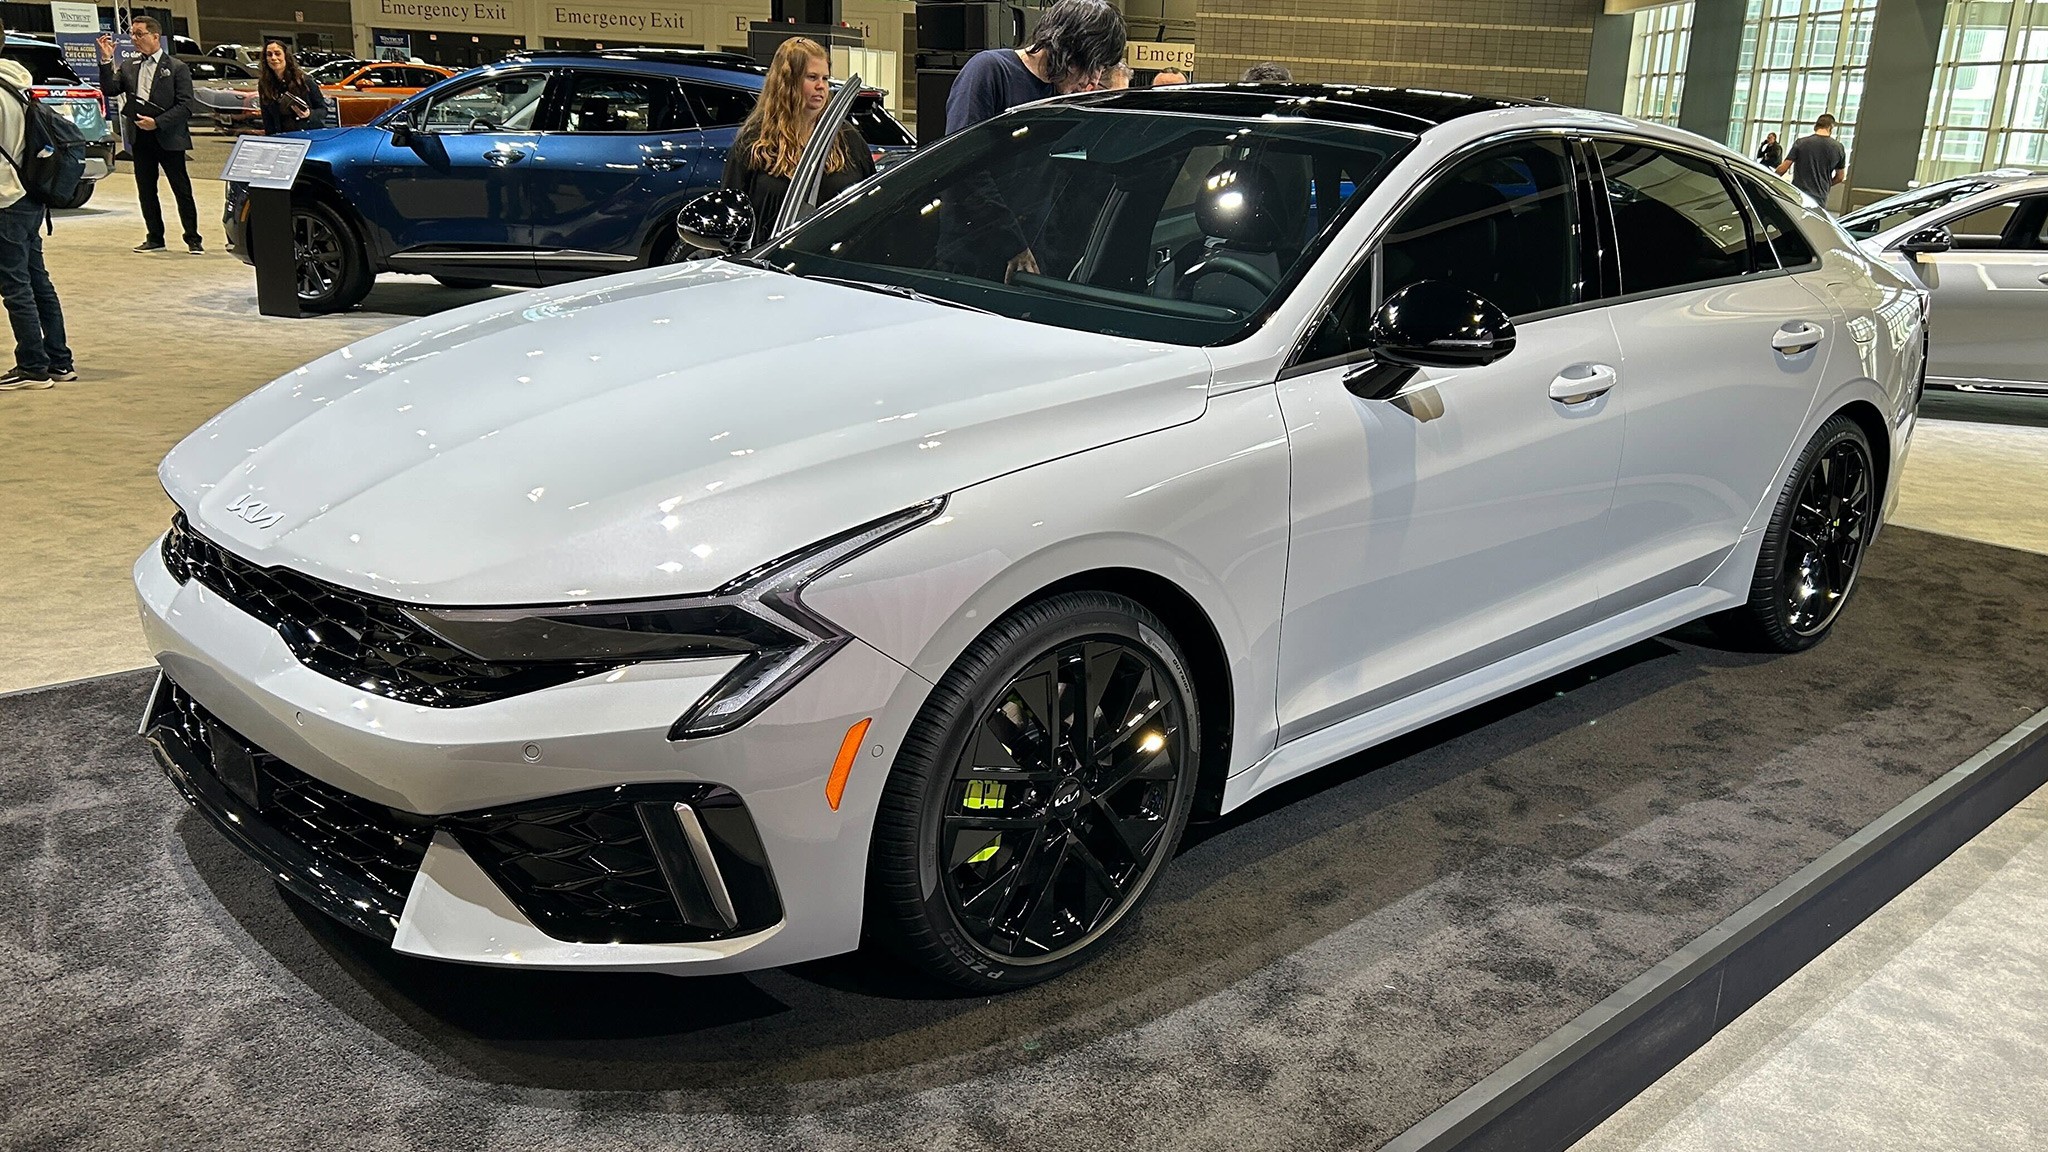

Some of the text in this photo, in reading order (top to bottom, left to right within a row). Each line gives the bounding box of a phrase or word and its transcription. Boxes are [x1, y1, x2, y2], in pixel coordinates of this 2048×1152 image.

[381, 0, 507, 22] Emergency Exit
[555, 7, 685, 31] Emergency Exit
[121, 50, 130, 58] Go
[1136, 45, 1194, 68] Emerg
[226, 492, 286, 530] KIA
[1054, 789, 1080, 808] KIA
